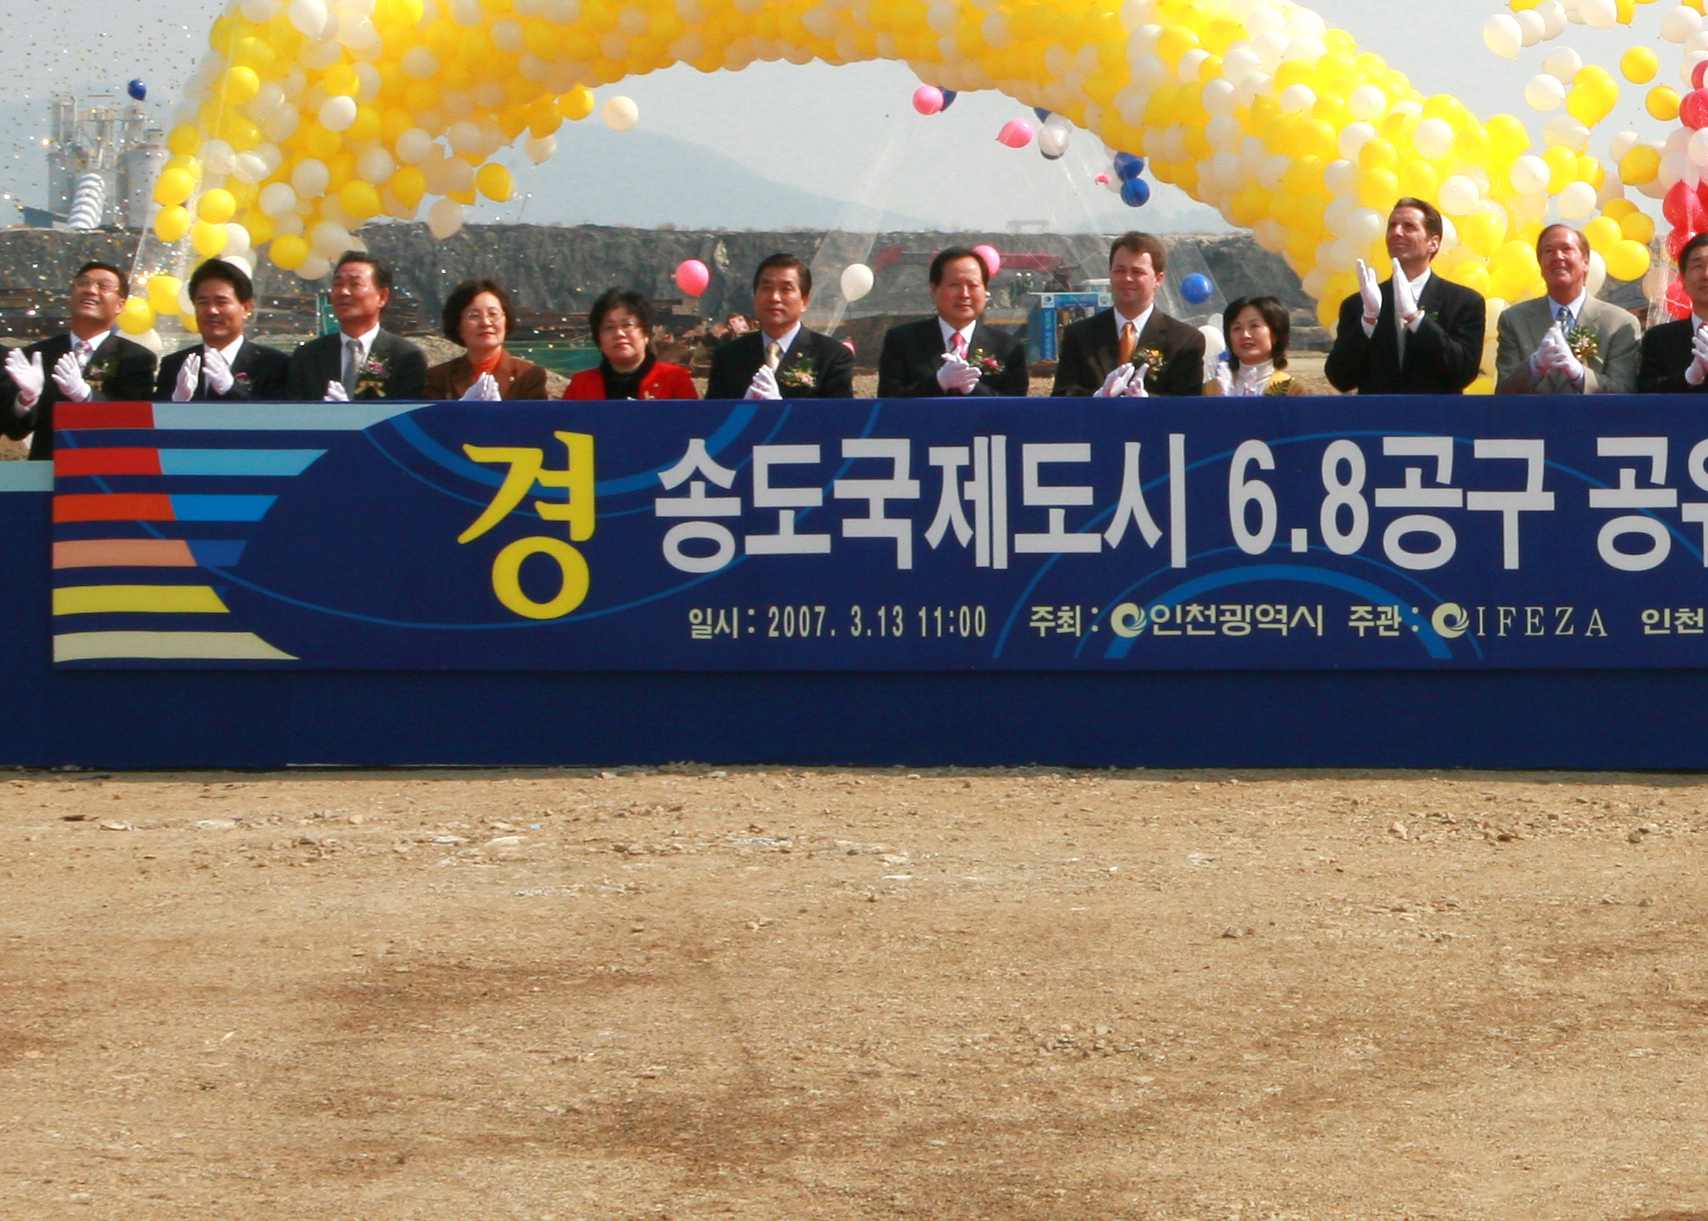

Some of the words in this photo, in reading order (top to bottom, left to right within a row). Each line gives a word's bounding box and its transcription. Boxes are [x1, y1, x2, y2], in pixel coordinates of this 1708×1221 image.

[655, 433, 1187, 573] 송도국제도시
[1228, 436, 1555, 570] 6.8공구
[457, 430, 595, 620] 경
[917, 605, 986, 637] 11:00
[1150, 603, 1323, 636] 인천광역시
[1476, 606, 1608, 637] IFEZA
